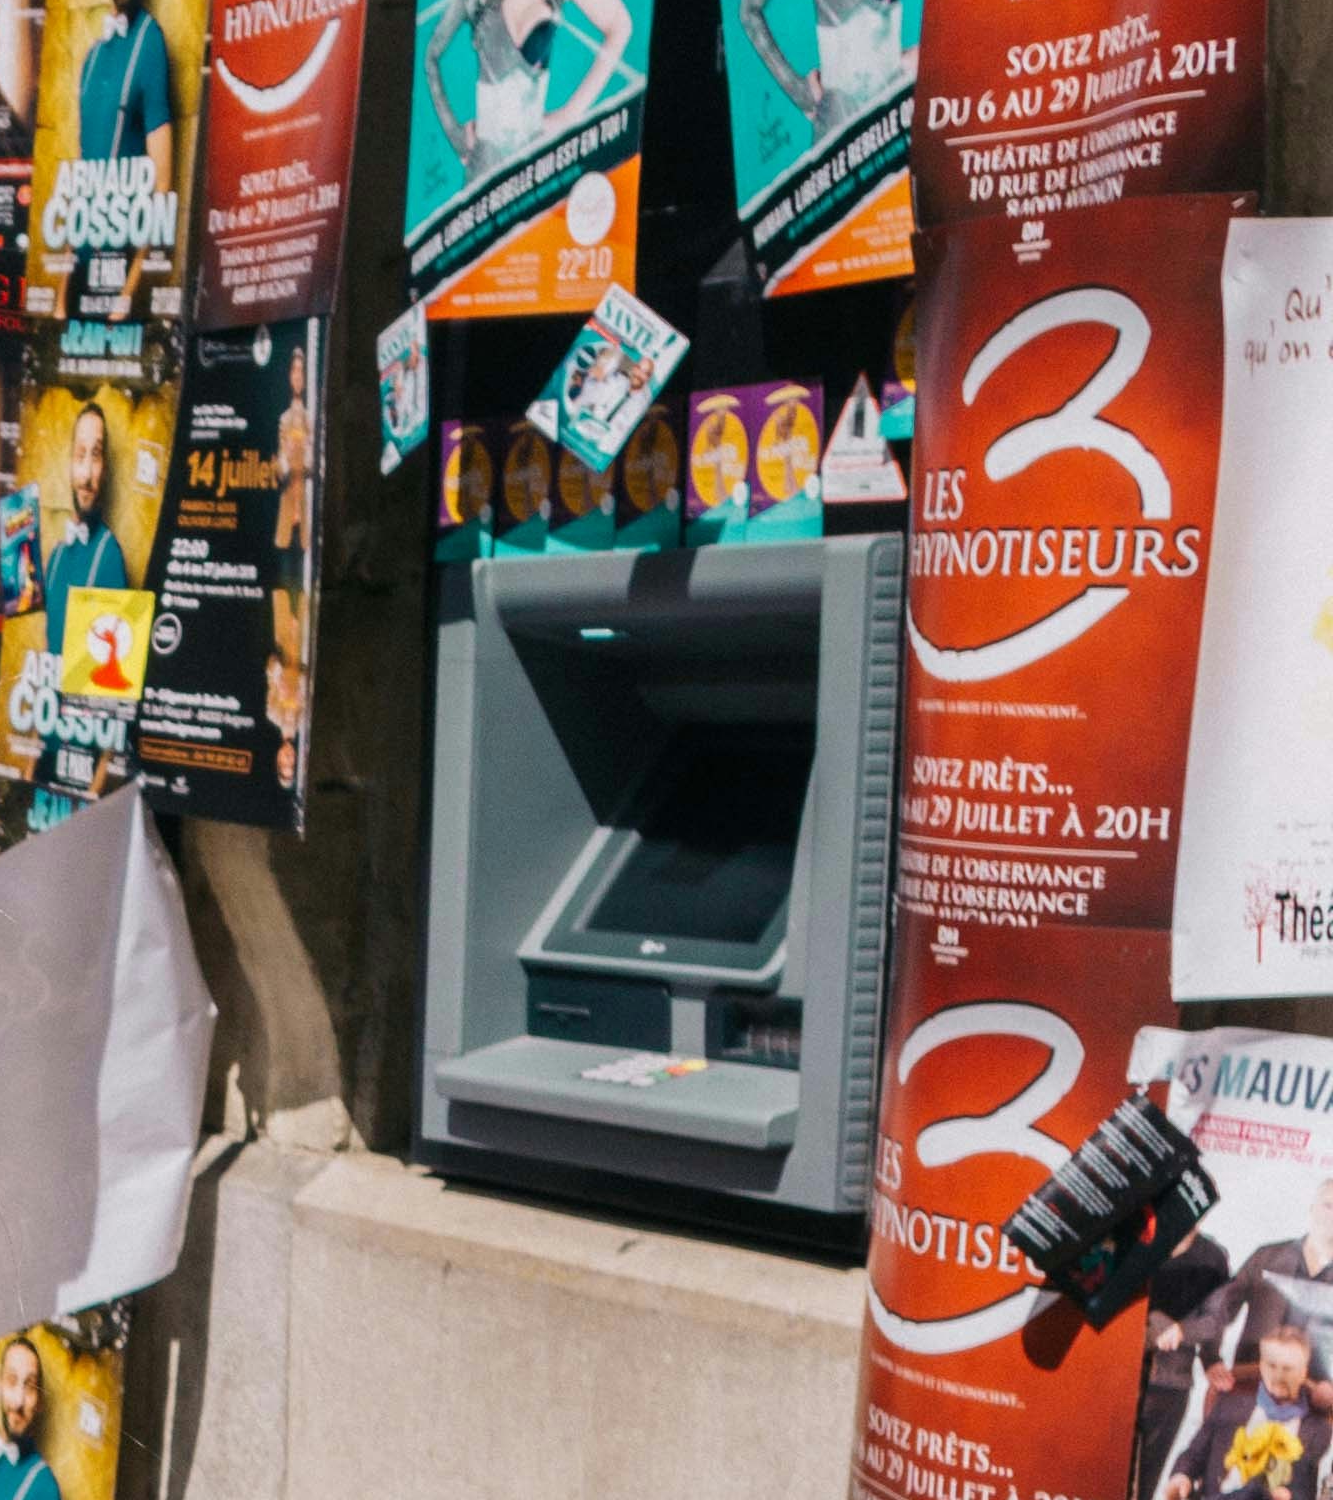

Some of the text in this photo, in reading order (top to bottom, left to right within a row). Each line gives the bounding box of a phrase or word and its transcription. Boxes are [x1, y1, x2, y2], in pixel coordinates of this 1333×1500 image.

[1004, 34, 1093, 79] SOYEZ
[927, 95, 971, 131] DU
[977, 89, 996, 123] 6
[1001, 86, 1044, 120] AU
[1048, 76, 1080, 112] 29
[1146, 48, 1163, 83] À
[1169, 37, 1237, 80] 20H
[55, 156, 158, 201] ARNAUD
[969, 175, 994, 200] 10
[998, 171, 1039, 197] RUE
[42, 192, 178, 250] COSSON
[186, 448, 278, 497] 14 juillet
[923, 468, 967, 522] LES
[911, 526, 1201, 579] HYPNOTISEURS
[913, 755, 1073, 795] SOYEZ PRÊTS...
[954, 797, 1055, 837] JUILLET
[1061, 802, 1084, 838] À
[1094, 804, 1171, 841] 20H
[953, 856, 1106, 890] L'OBSERVANCE
[942, 882, 1089, 917] L'OBSERVANCE
[868, 1403, 1014, 1478] SOYEZ PRÊTS...
